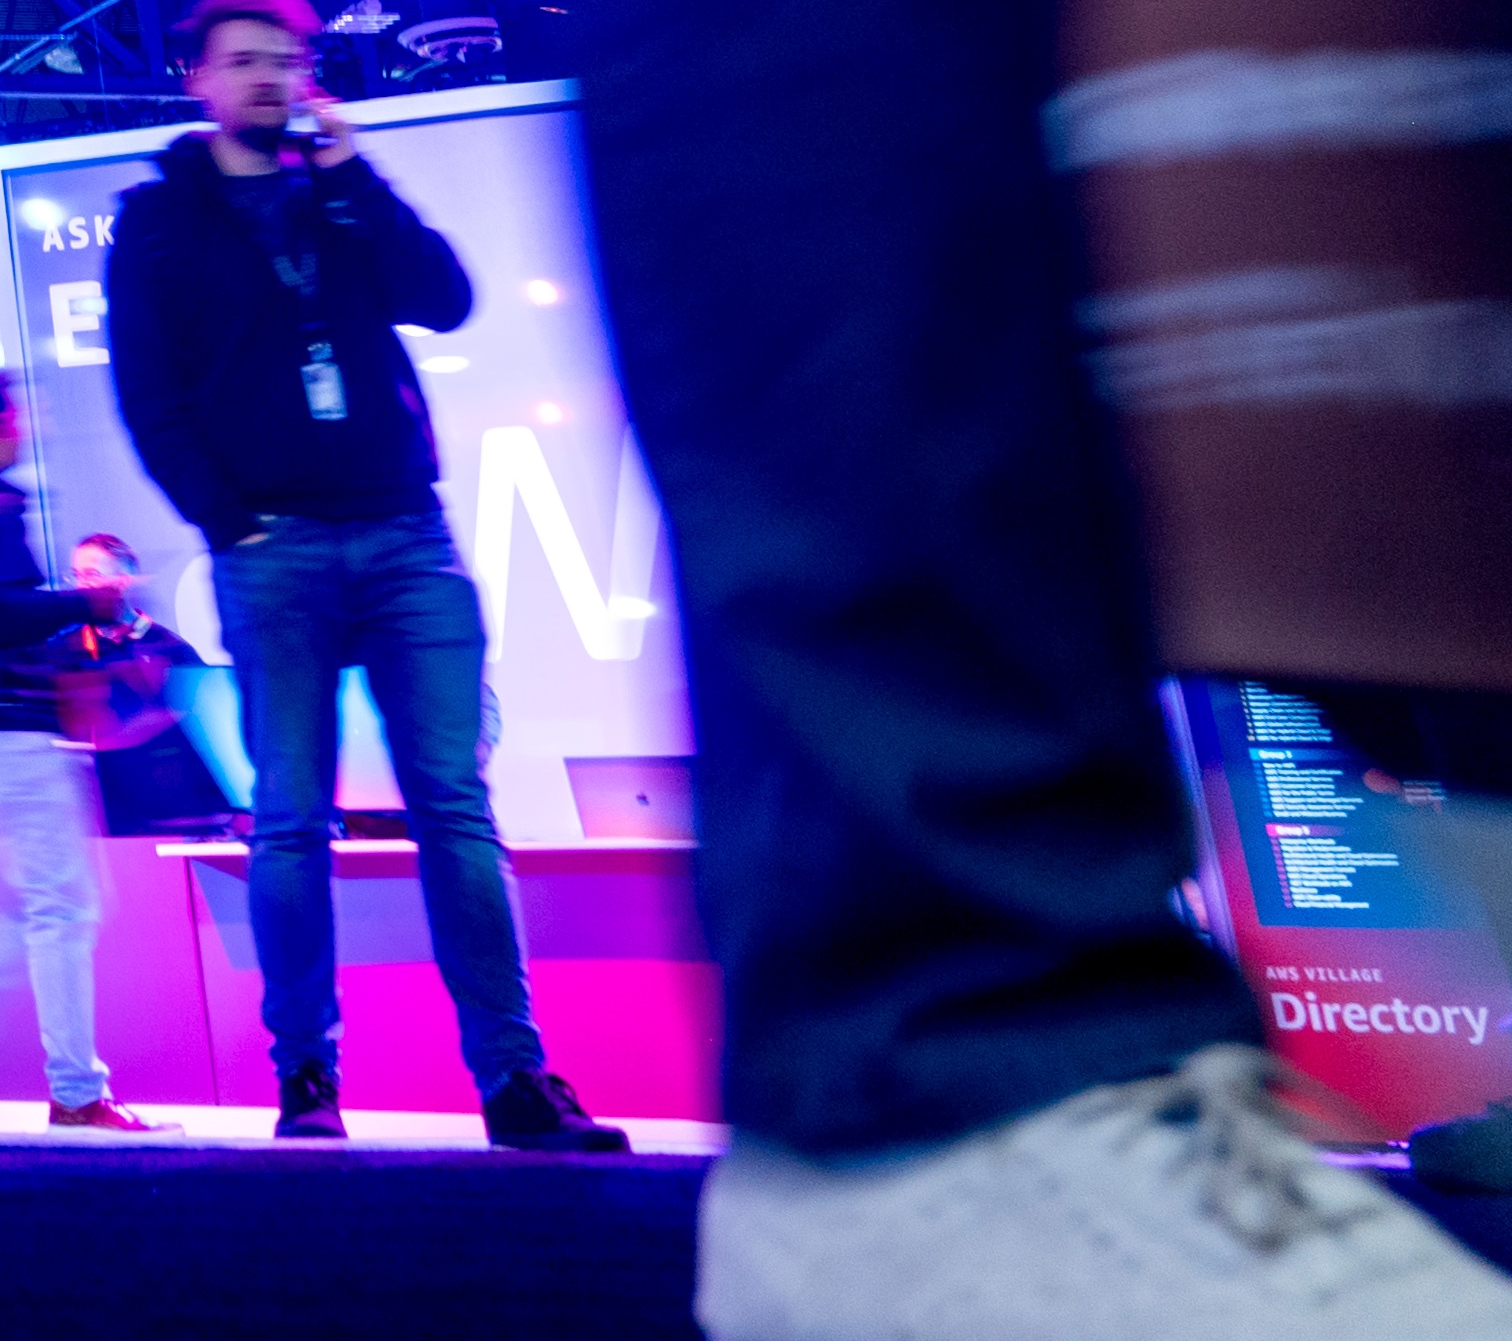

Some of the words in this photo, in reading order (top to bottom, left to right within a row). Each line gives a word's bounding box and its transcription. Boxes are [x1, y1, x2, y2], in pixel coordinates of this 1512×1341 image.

[43, 214, 115, 253] ASK
[1266, 966, 1300, 981] AWS
[1303, 967, 1383, 983] VILLAGE
[1271, 990, 1489, 1045] Directory
